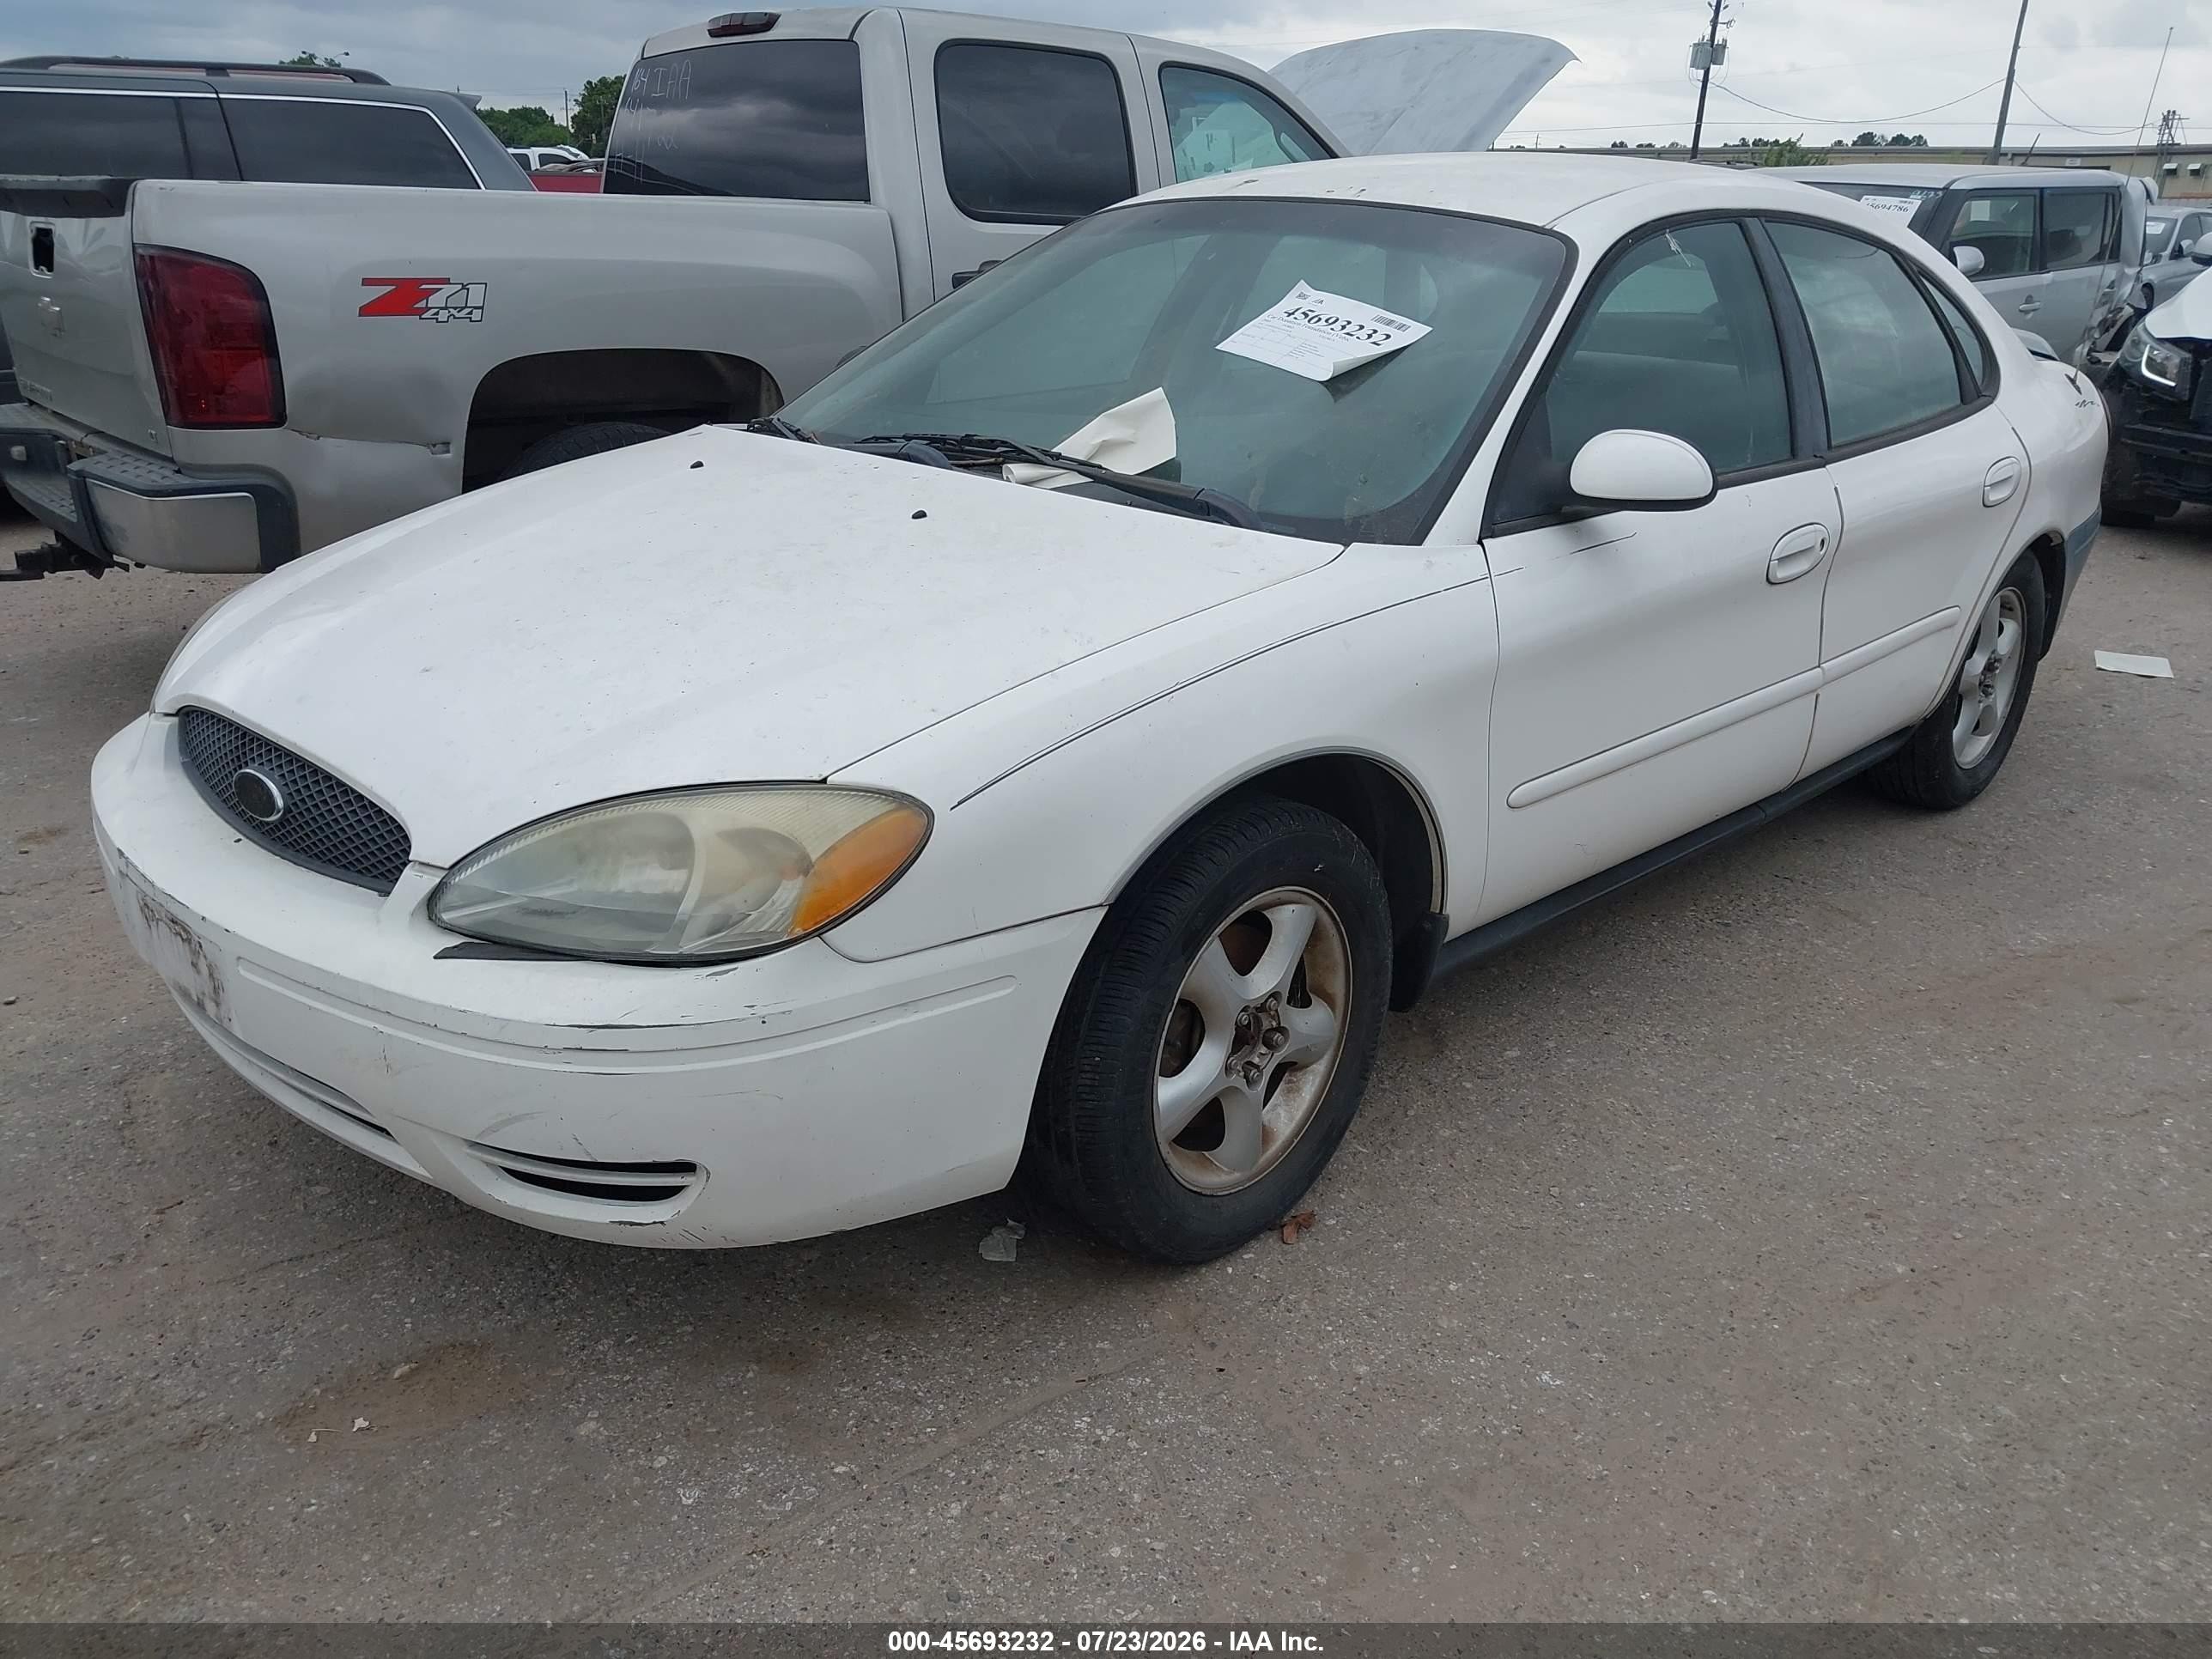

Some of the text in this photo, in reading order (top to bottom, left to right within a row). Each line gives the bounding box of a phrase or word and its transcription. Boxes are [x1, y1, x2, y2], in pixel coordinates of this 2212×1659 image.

[651, 59, 691, 100] IAA
[358, 276, 488, 318] Z71
[1283, 306, 1393, 347] 45693232
